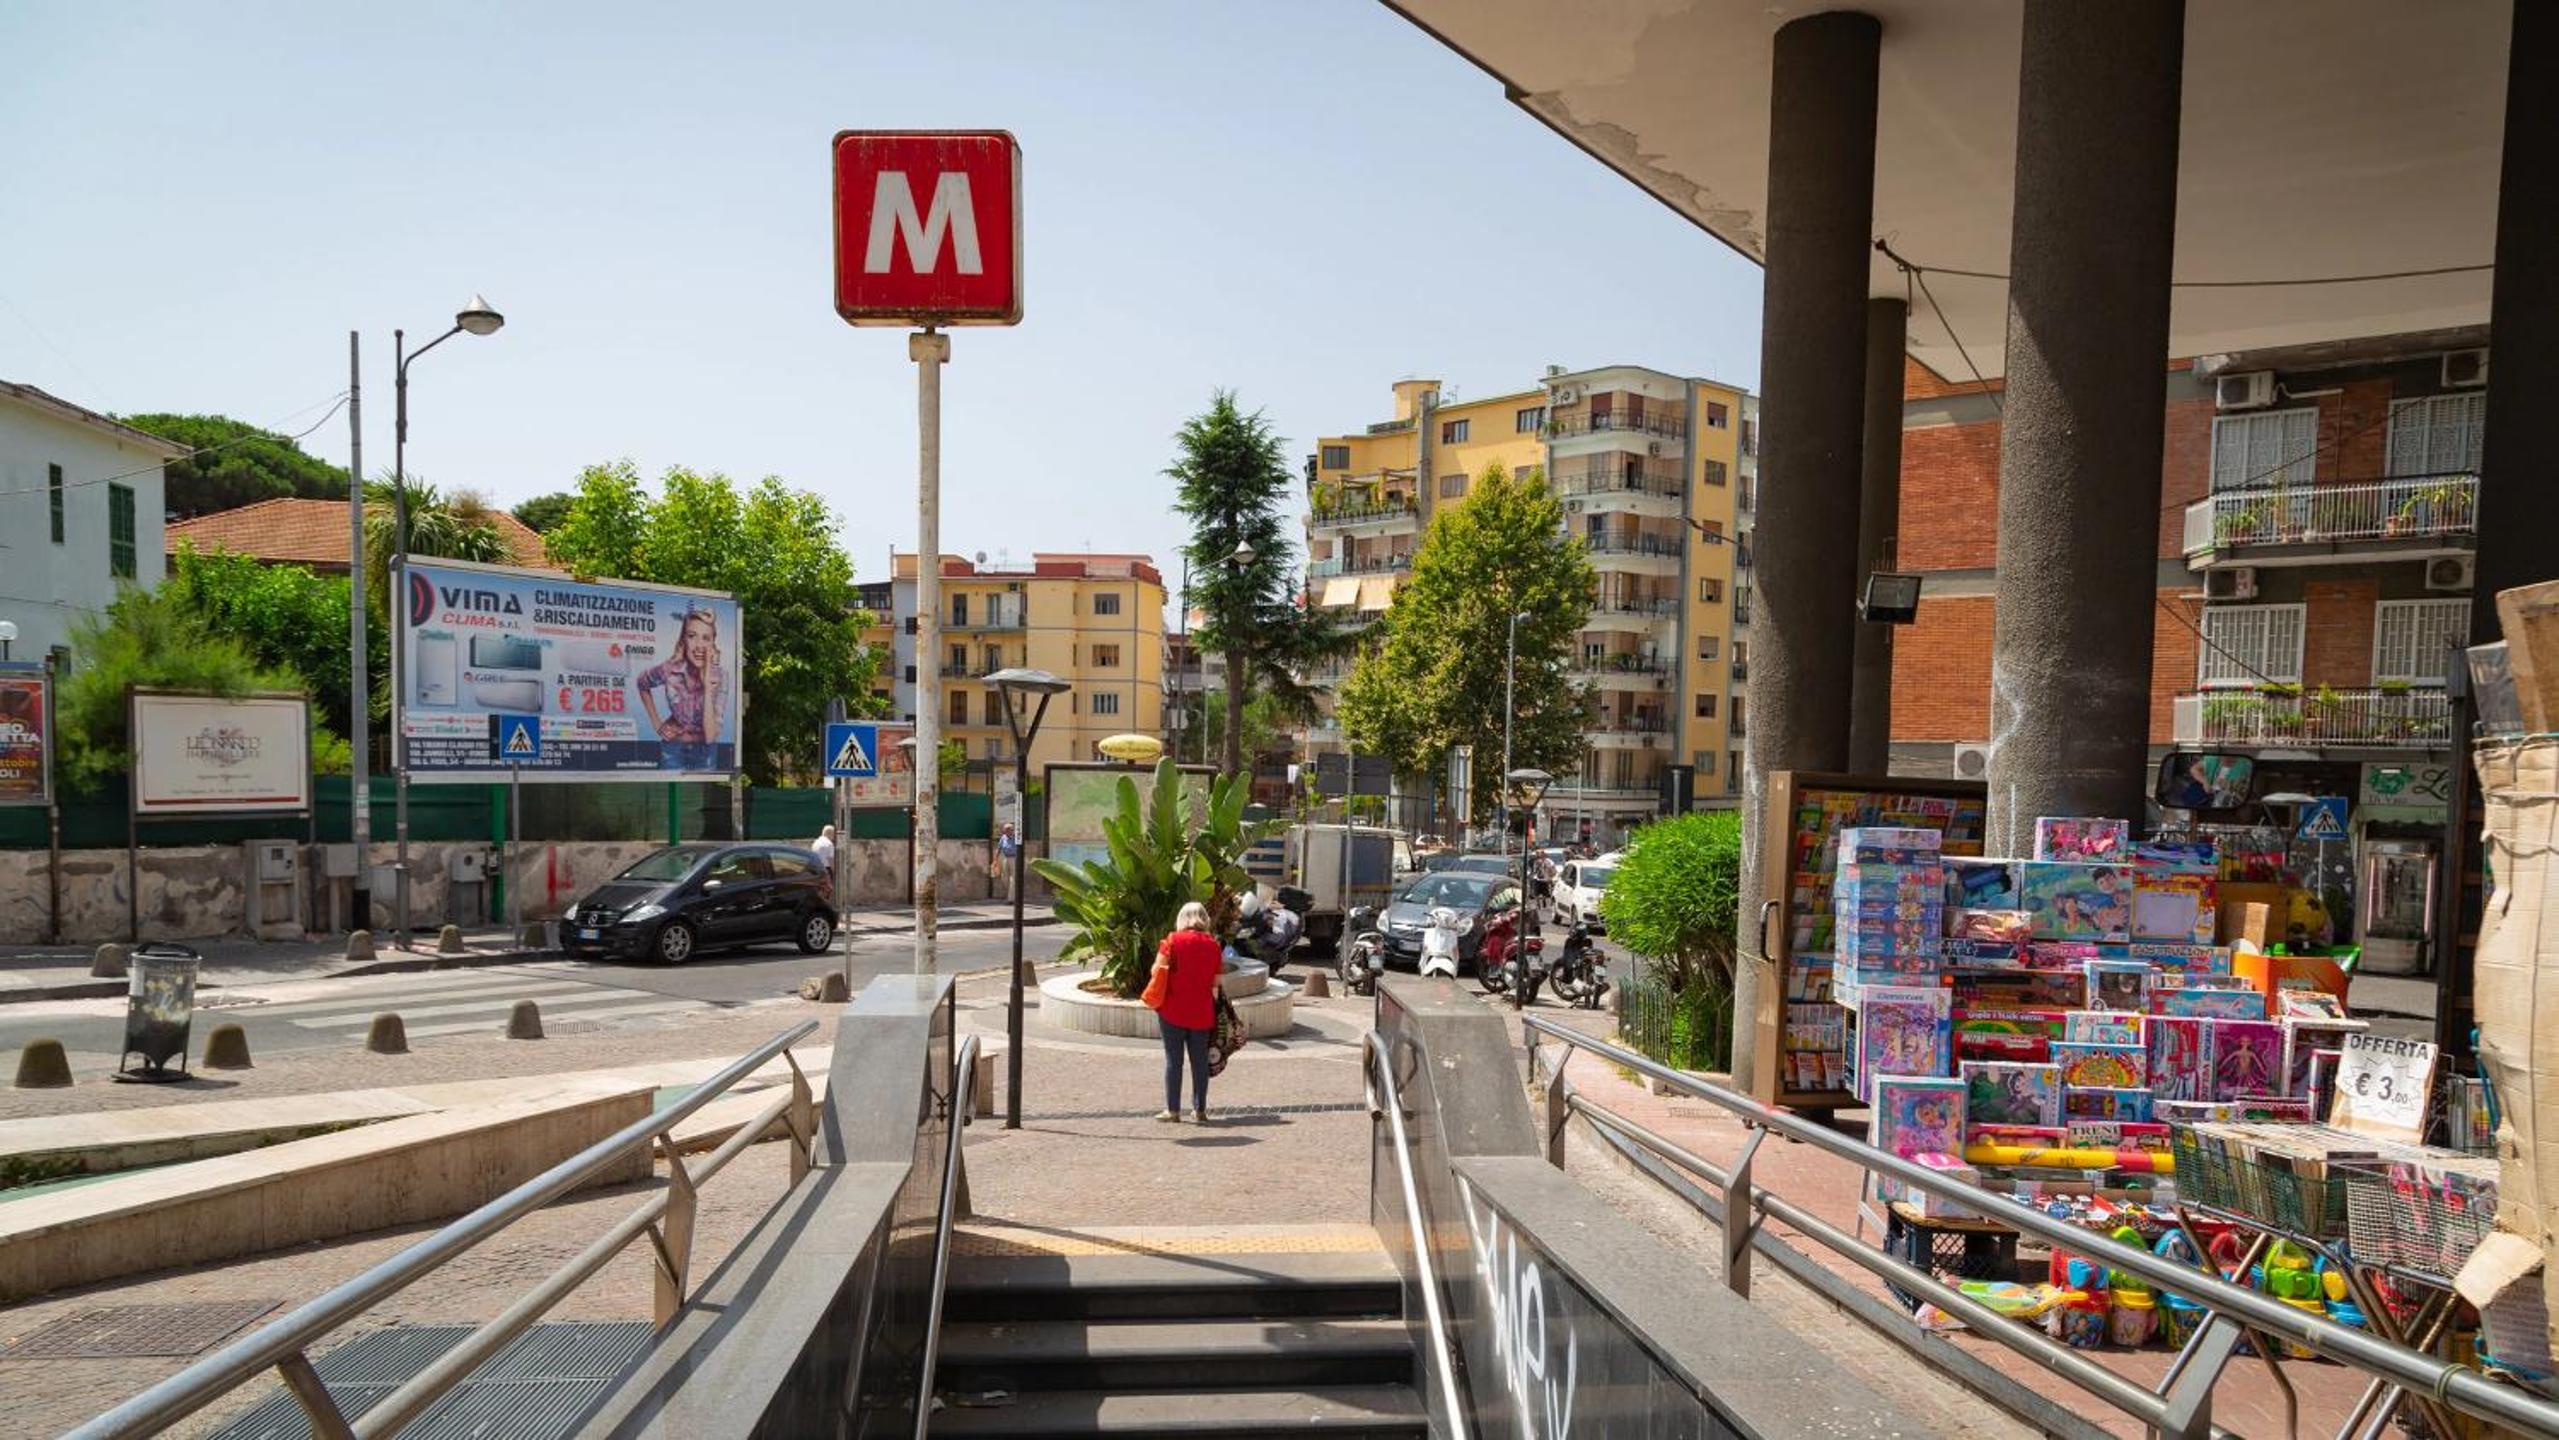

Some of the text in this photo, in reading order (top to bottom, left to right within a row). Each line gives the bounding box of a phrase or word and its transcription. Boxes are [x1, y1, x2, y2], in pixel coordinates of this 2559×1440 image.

[863, 170, 984, 276] M
[534, 589, 656, 615] CLIMATIZZAZIONE
[441, 611, 497, 629] CLIMA
[533, 608, 656, 633] &RISCALDAMENTO
[557, 673, 565, 685] A
[567, 674, 609, 687] PARTIRE
[558, 687, 625, 712] € 265
[2350, 1034, 2429, 1060] OFFERTA
[2354, 1072, 2372, 1096] €
[2071, 1126, 2119, 1137] TRENI
